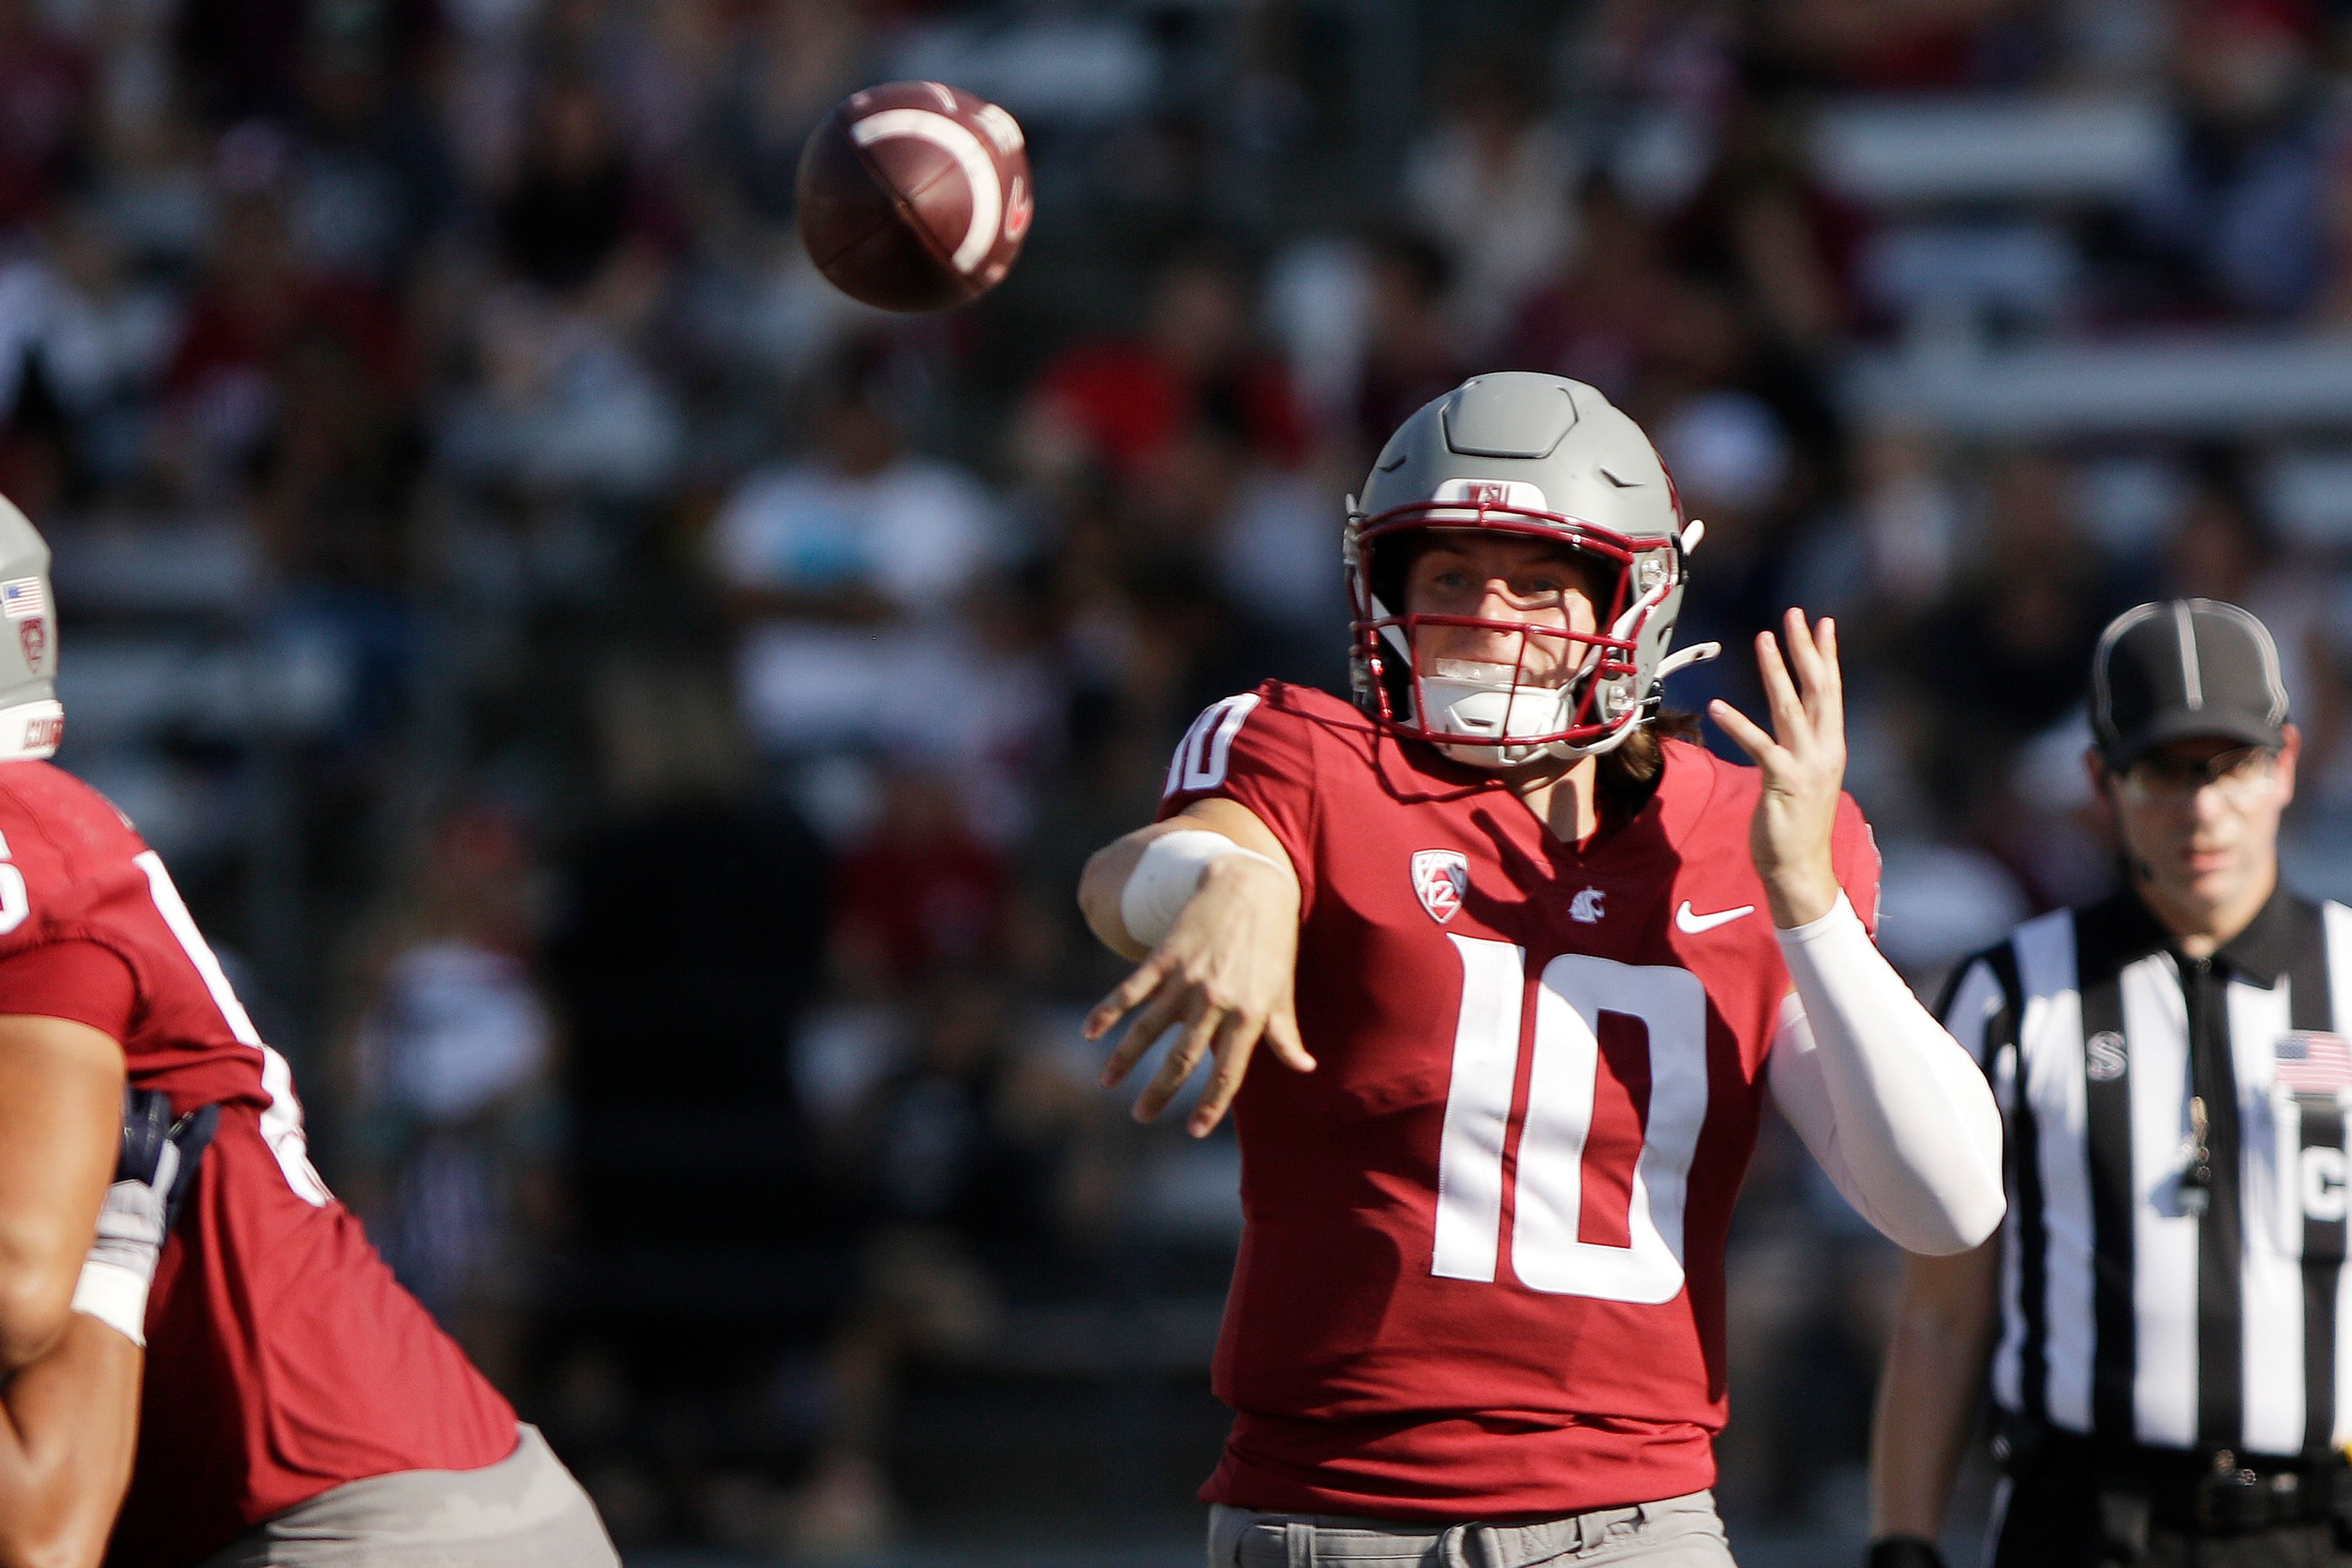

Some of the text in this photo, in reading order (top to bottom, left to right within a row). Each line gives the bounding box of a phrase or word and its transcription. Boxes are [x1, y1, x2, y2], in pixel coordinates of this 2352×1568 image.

[1163, 693, 1261, 799] 10
[1428, 880, 1461, 907] 12
[1431, 932, 1708, 1305] 10
[2301, 1145, 2348, 1222] C
